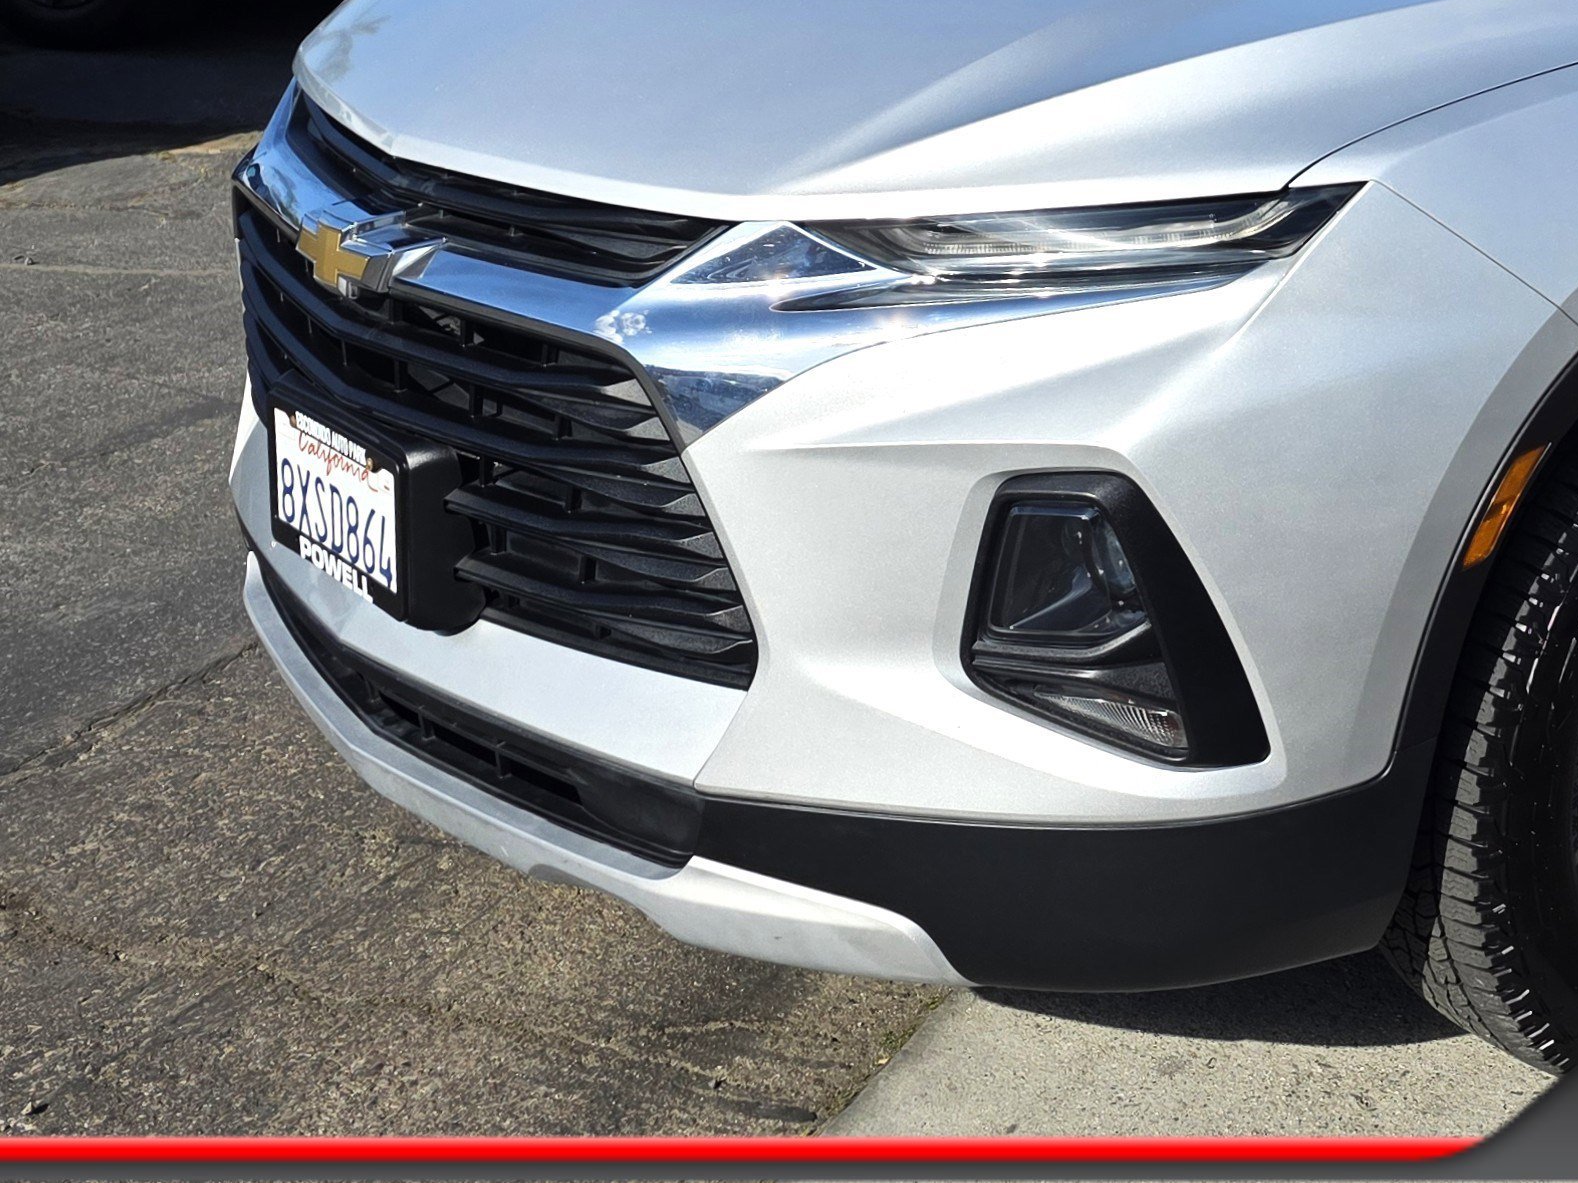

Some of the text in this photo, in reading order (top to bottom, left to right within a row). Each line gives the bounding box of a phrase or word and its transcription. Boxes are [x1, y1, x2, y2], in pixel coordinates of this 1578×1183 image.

[298, 430, 379, 493] California
[281, 457, 393, 589] 8XSD864
[298, 533, 374, 605] POWELL
